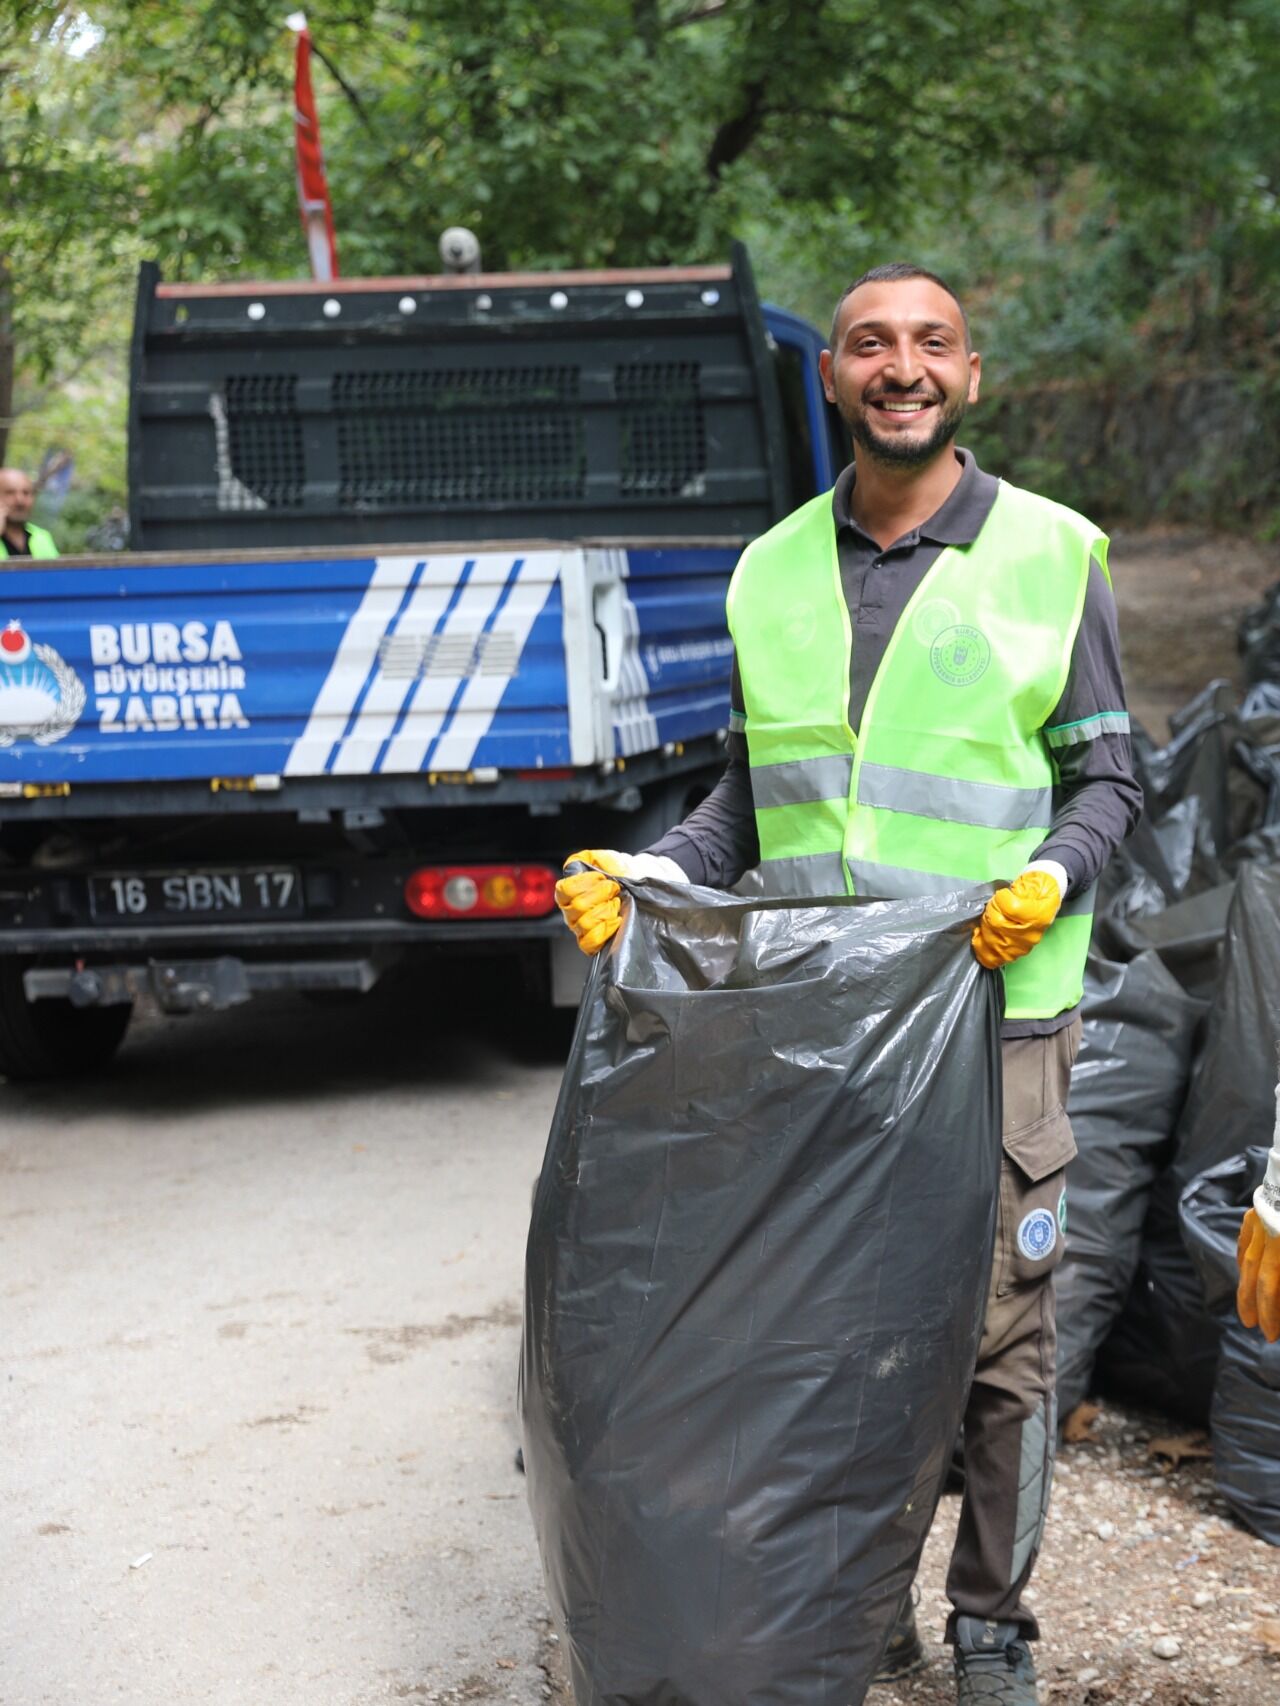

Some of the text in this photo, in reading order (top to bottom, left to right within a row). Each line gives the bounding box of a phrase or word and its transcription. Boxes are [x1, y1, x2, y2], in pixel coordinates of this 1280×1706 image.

[90, 621, 242, 665] BURSA
[94, 661, 246, 696] BÜYÜKŞEHİR
[96, 693, 250, 734] ZABITA
[111, 873, 294, 914] 16 SBN 17
